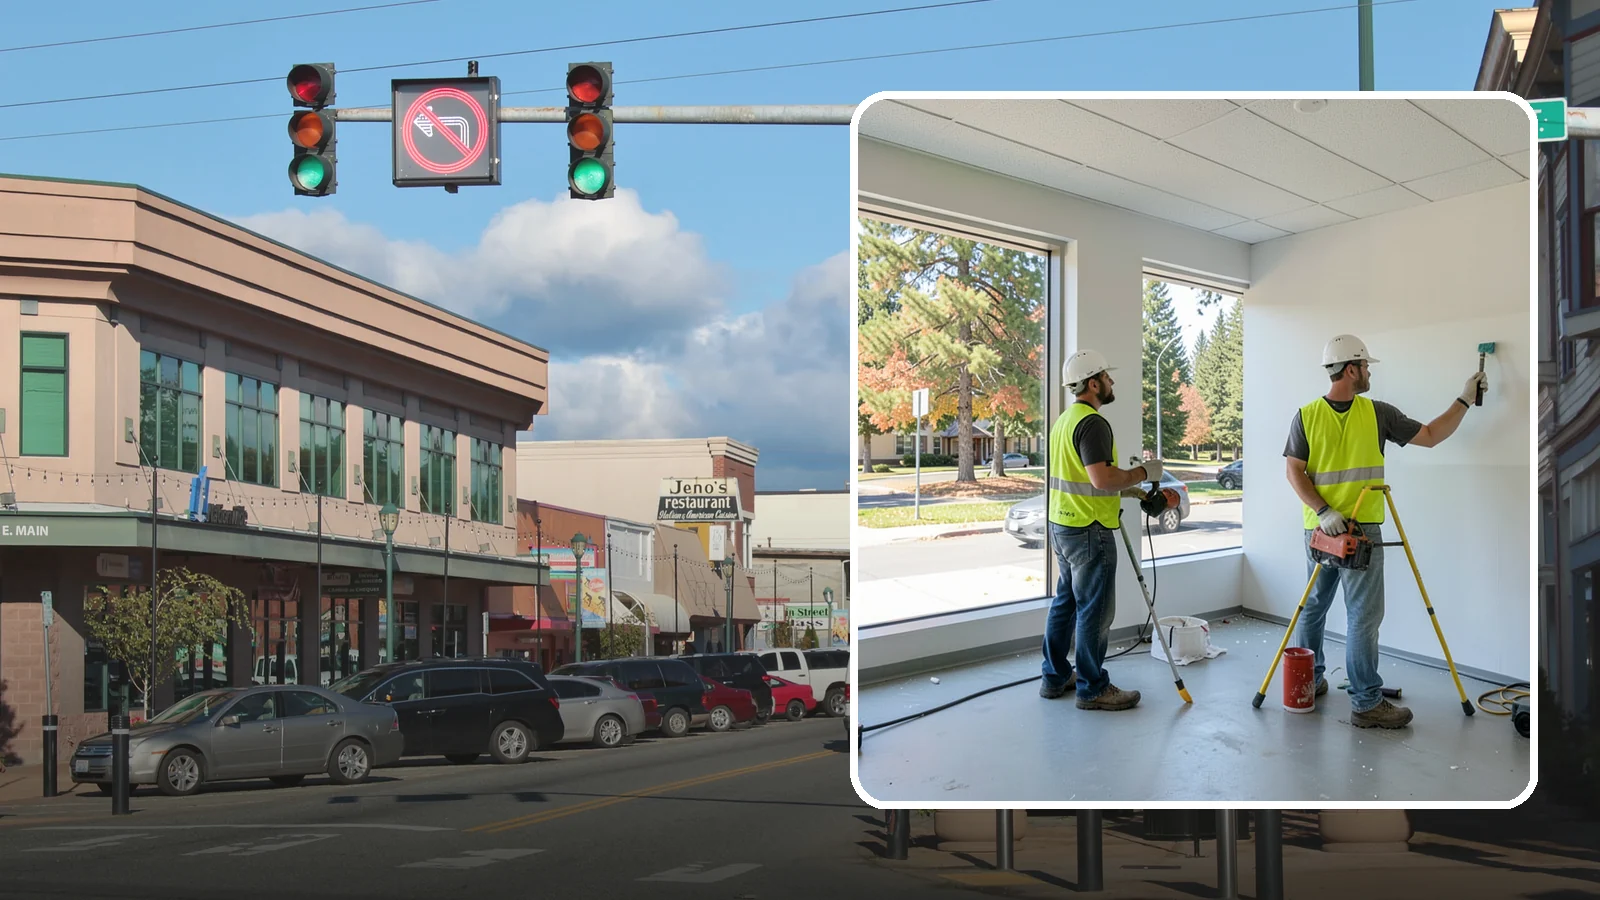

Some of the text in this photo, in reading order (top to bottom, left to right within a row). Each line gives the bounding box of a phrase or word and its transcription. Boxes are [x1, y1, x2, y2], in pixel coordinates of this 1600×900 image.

[670, 480, 727, 494] Jeno's
[665, 497, 731, 508] restaurant
[658, 510, 681, 519] Italian
[686, 509, 714, 519] American
[715, 509, 738, 519] Cuisine
[2, 525, 49, 536] E. MAIN
[797, 607, 828, 617] Street
